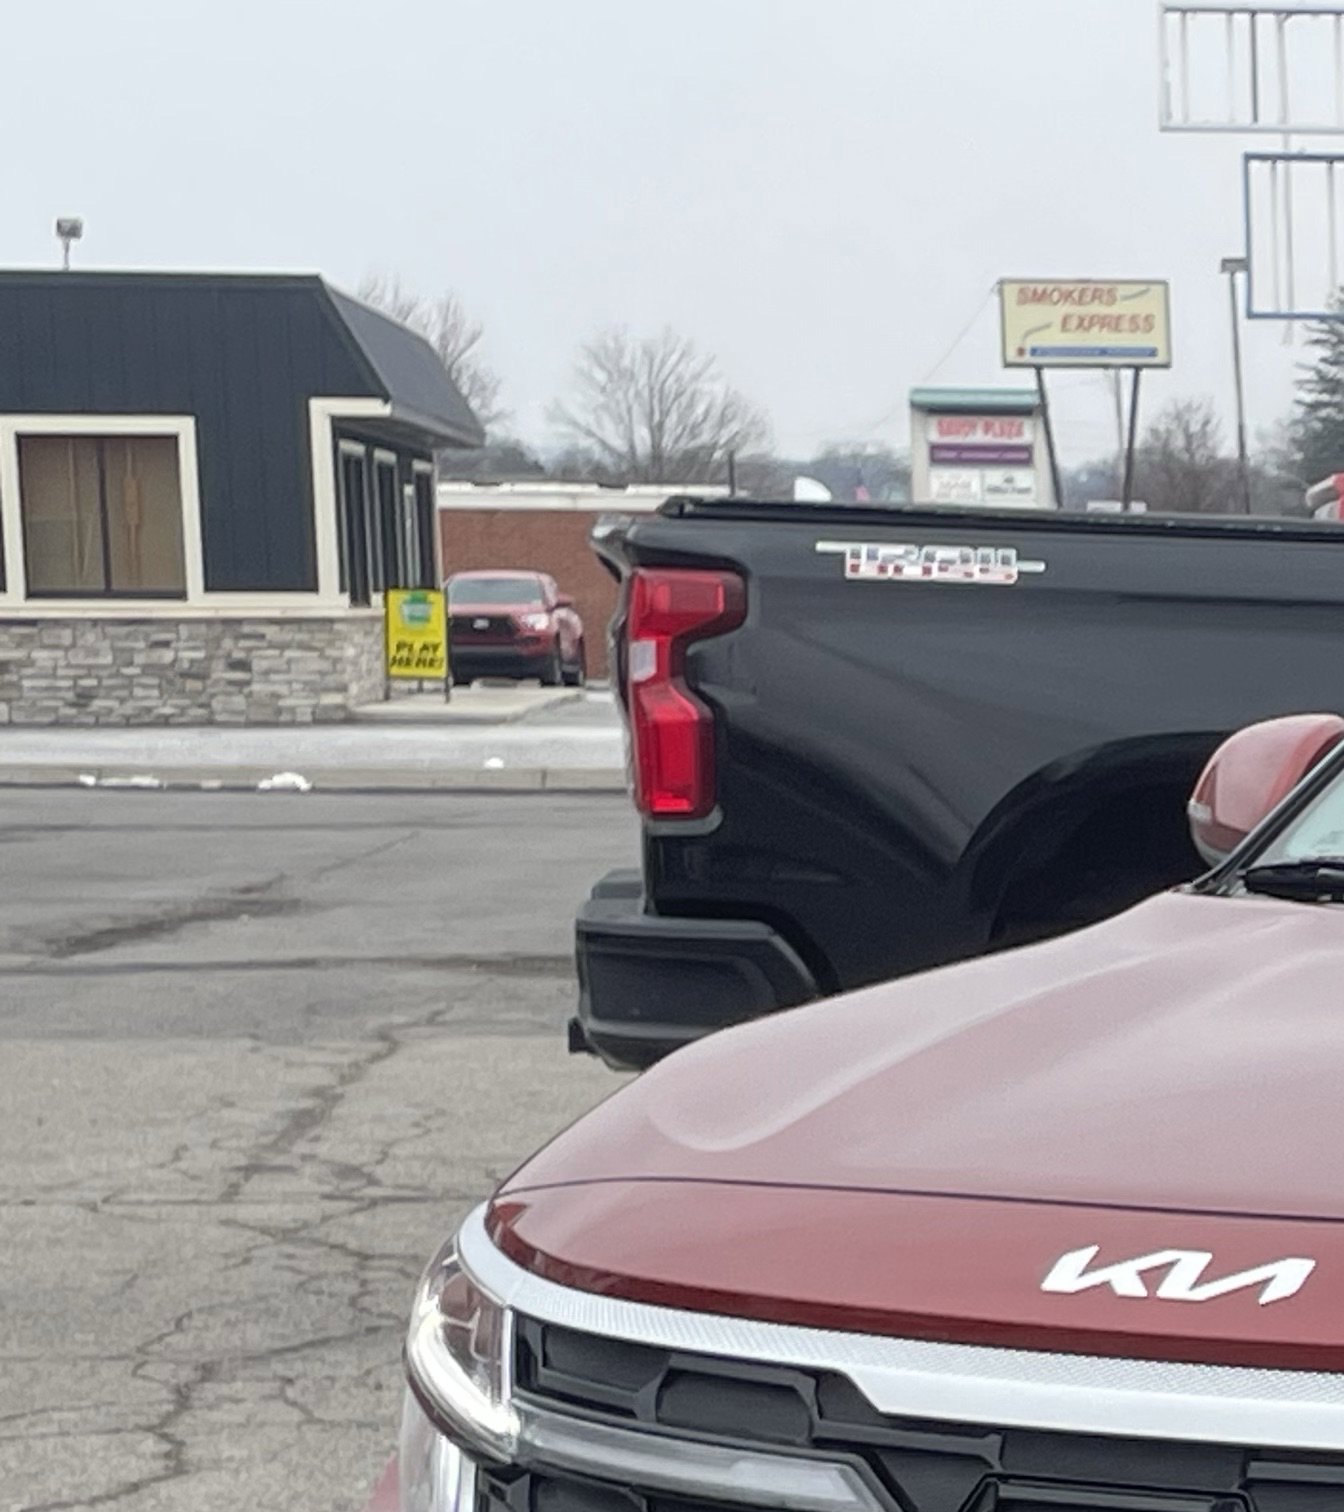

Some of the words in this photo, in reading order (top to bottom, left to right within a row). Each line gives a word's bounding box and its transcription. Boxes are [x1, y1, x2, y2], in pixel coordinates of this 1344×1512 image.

[1017, 286, 1118, 306] SMOKERS
[1060, 313, 1155, 333] EXPRESS
[395, 641, 441, 656] PLAY
[1040, 1245, 1316, 1306] KIA
